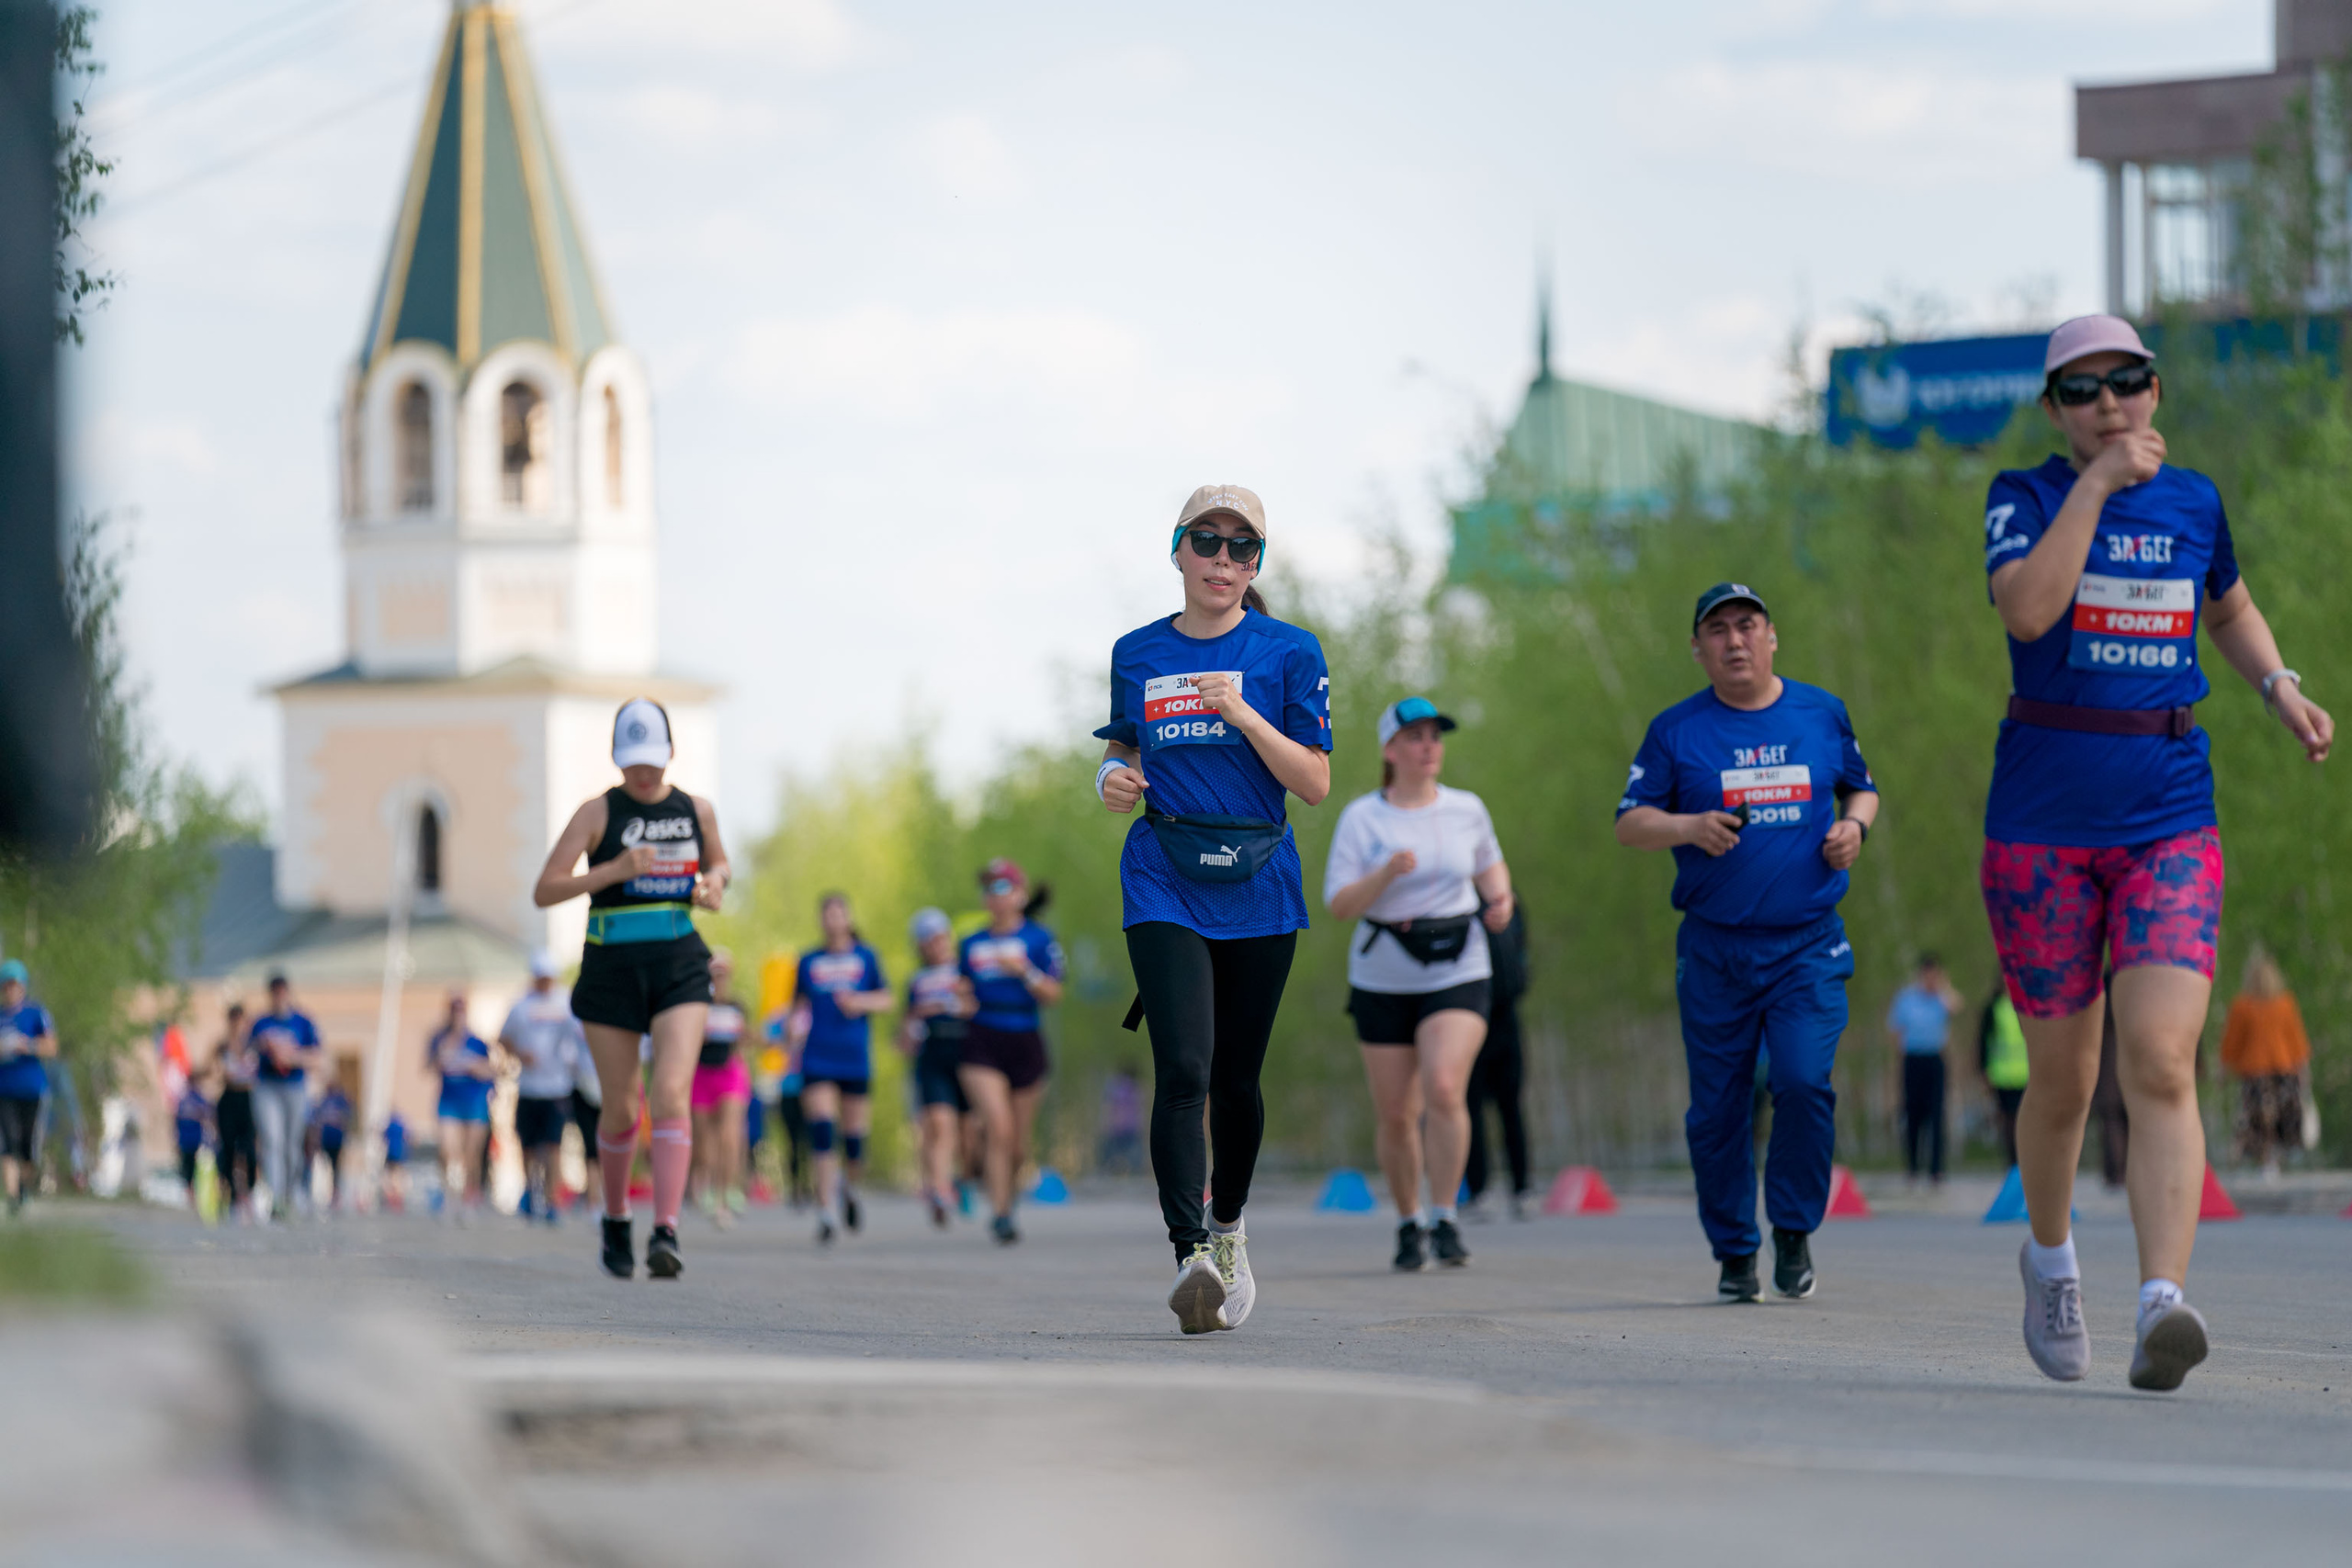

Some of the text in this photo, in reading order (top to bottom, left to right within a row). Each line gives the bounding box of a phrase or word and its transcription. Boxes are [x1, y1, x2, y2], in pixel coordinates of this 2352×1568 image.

[1156, 721, 1227, 741] 10184
[1748, 806, 1802, 825] 0015
[1199, 852, 1233, 867] PUMA
